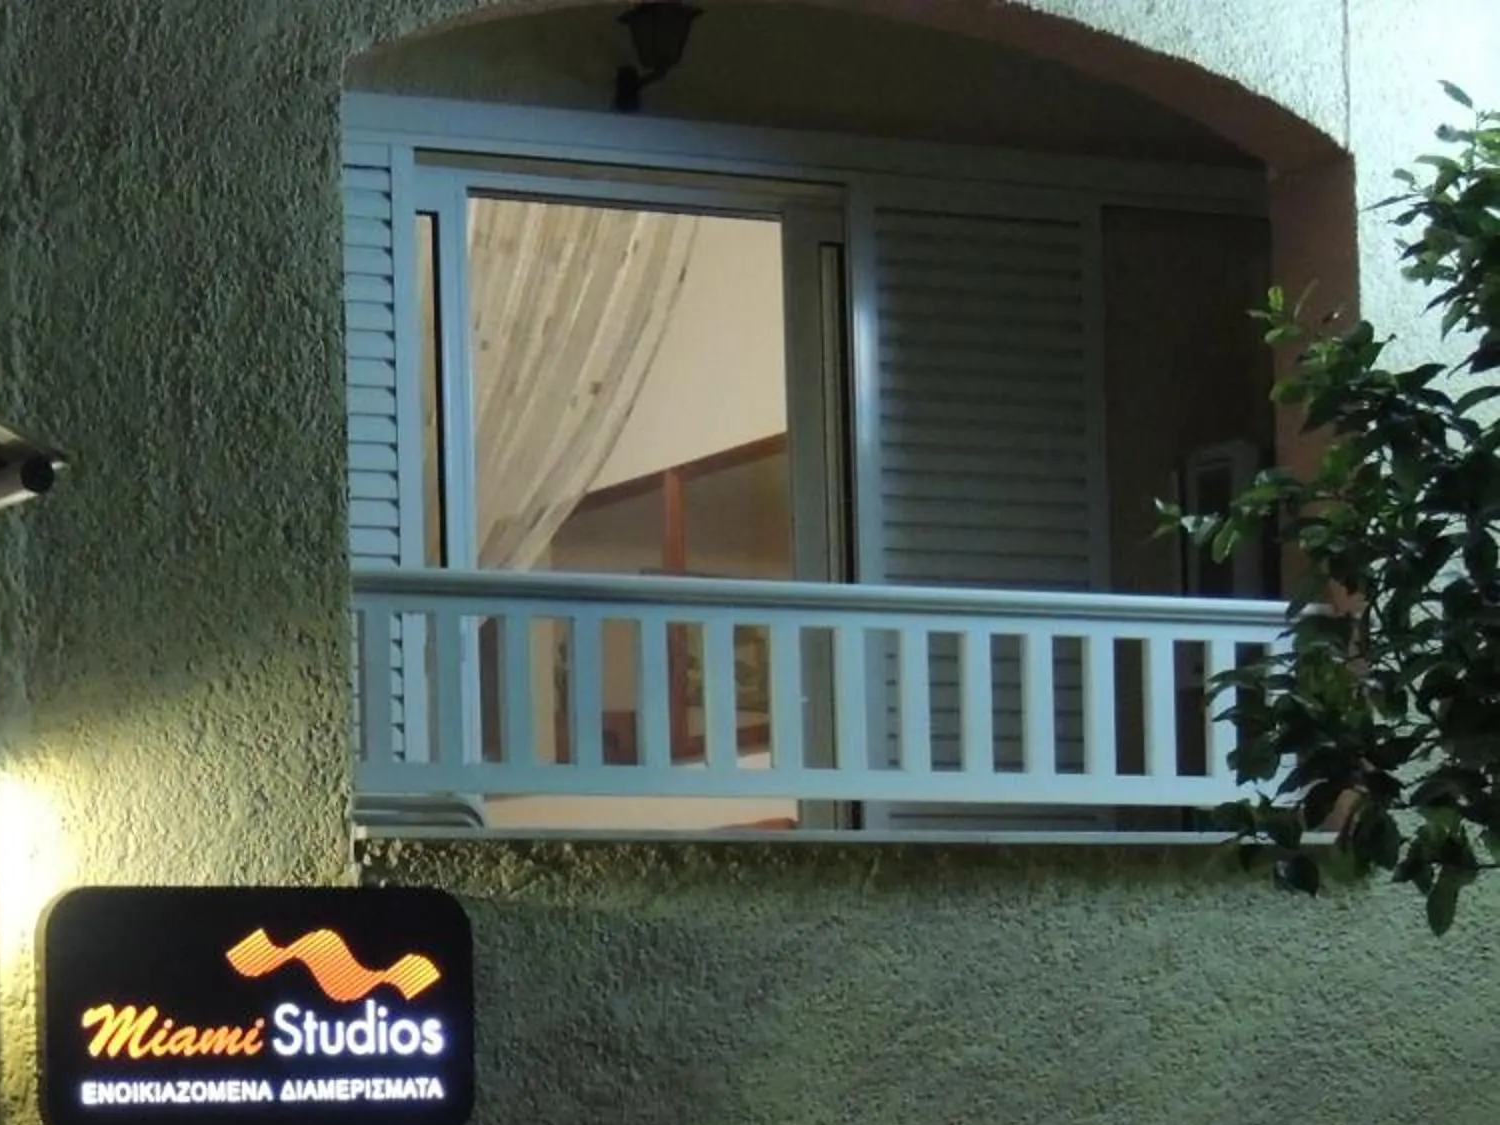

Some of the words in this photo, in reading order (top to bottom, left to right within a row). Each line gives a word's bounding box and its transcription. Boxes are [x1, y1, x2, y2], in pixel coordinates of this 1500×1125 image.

[81, 1003, 266, 1059] Miami
[273, 999, 445, 1057] Studios
[80, 1079, 273, 1106] ΕΝΟΙΚΙΑΖΟΜΕΝΑ
[280, 1076, 445, 1102] ΔΙΑΜΕΡΙΣΜΑΤΑ
